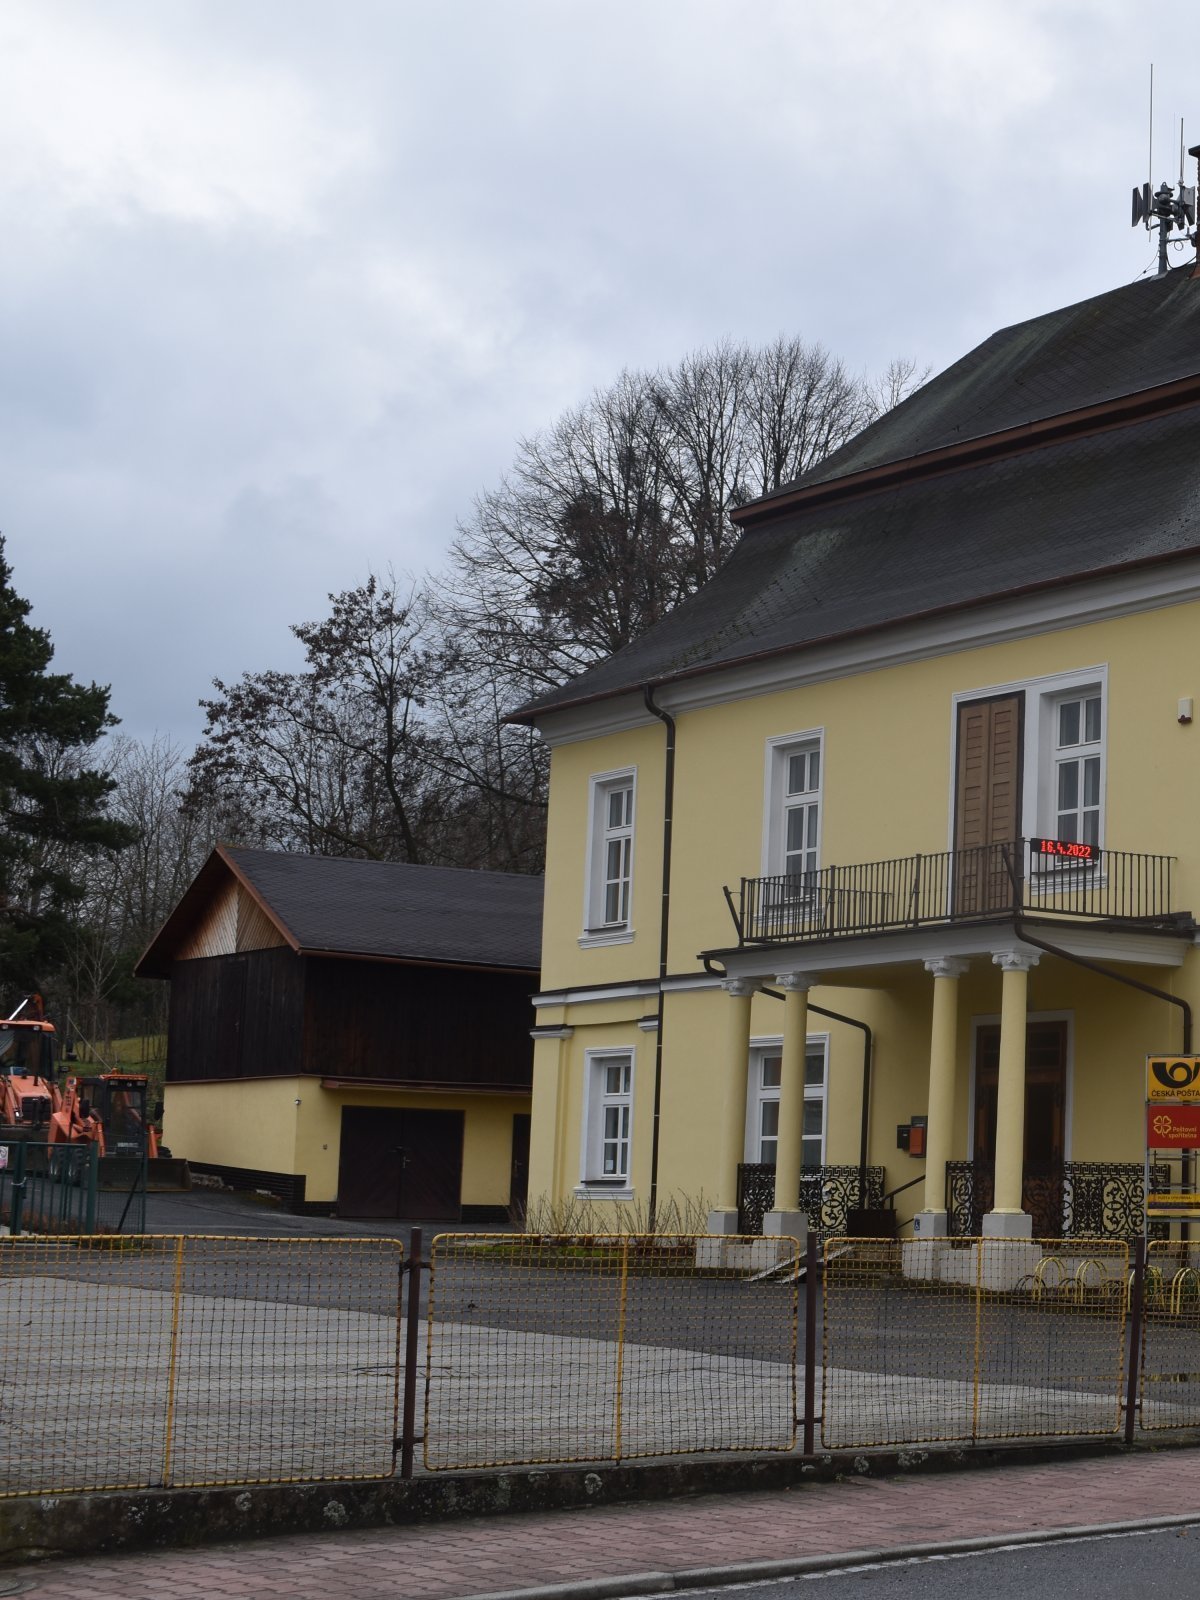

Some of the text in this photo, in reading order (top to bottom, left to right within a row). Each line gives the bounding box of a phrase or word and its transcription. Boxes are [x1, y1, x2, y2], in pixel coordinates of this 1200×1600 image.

[1041, 840, 1091, 858] 16.4.2022
[1151, 1089, 1200, 1097] ČESKÁ POŠTA
[1172, 1125, 1197, 1133] Poštovní
